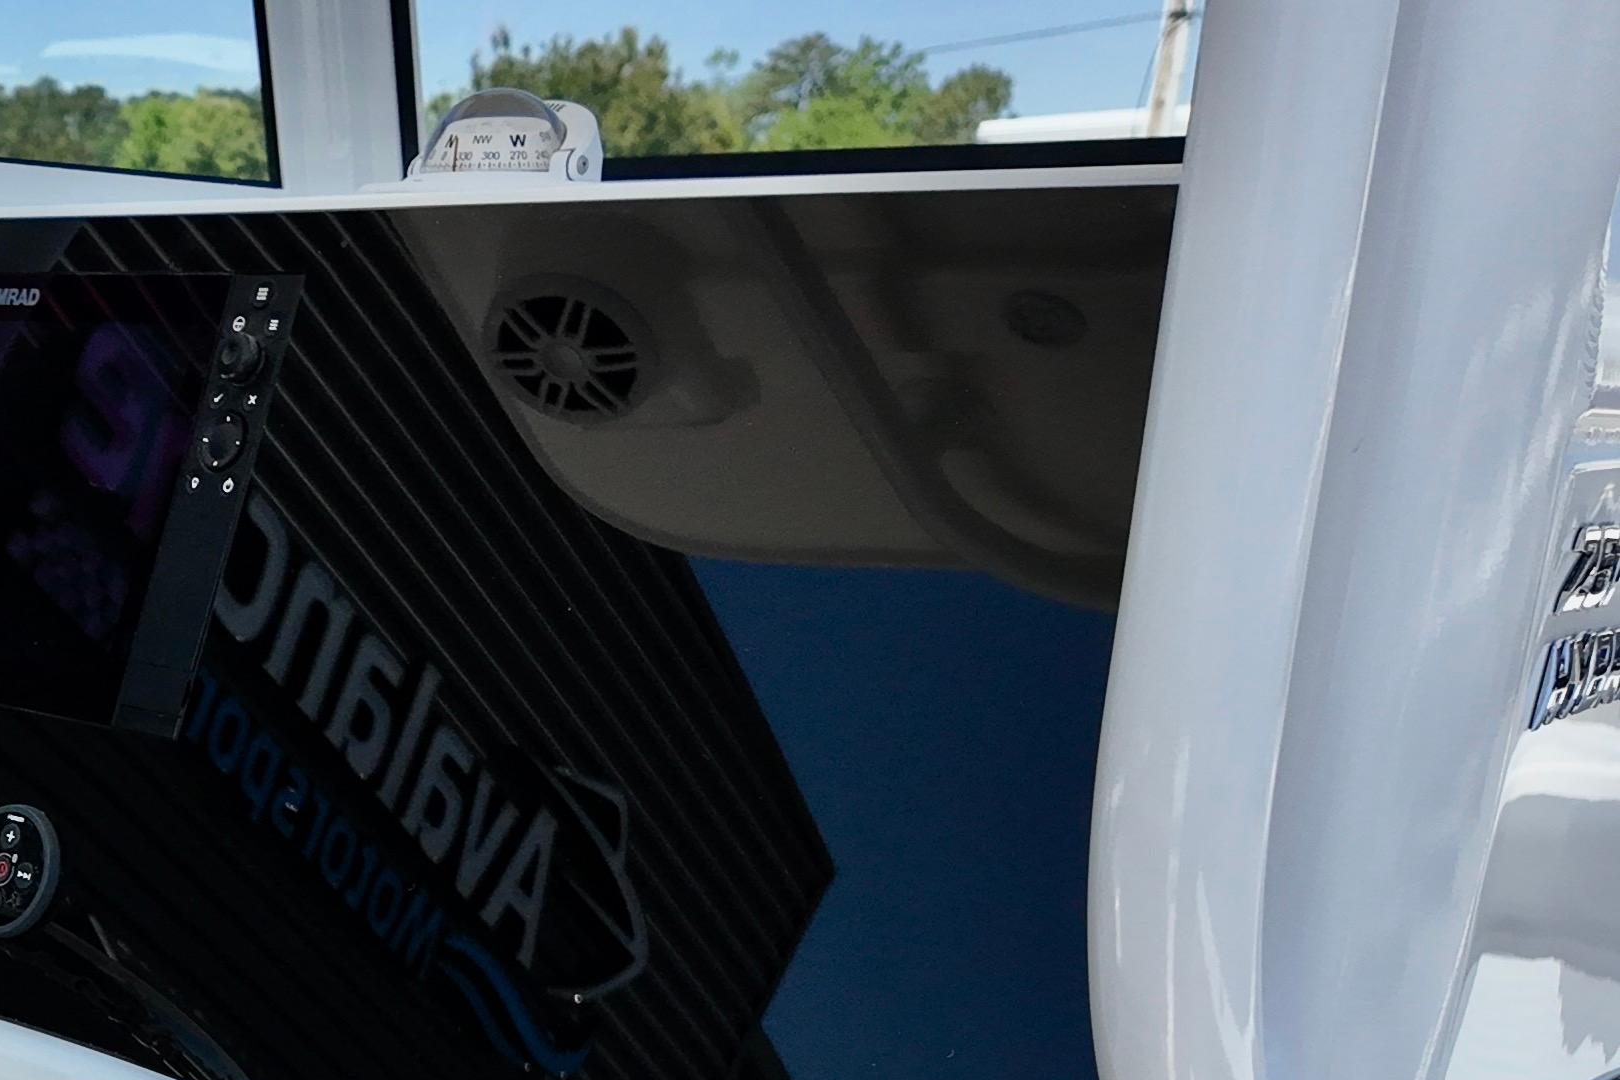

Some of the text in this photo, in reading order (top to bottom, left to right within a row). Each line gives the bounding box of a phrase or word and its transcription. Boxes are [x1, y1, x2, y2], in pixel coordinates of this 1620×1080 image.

[472, 135, 492, 145] NW
[509, 134, 527, 148] W
[510, 151, 527, 160] 270
